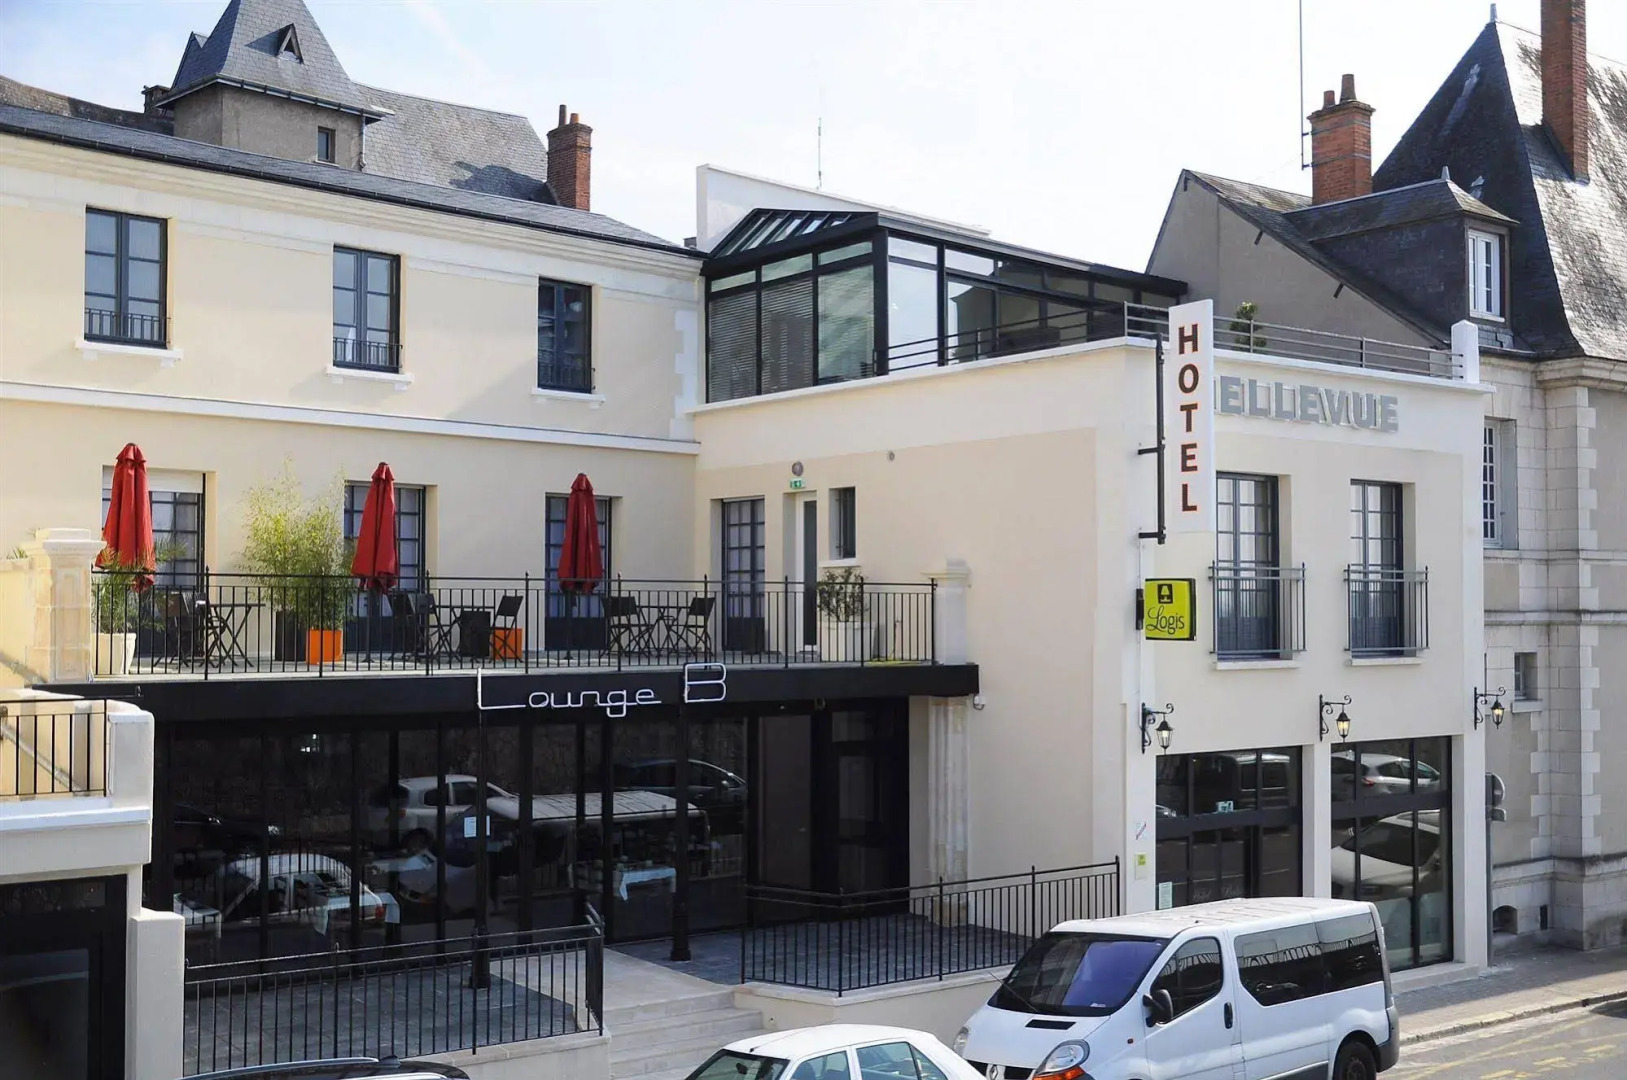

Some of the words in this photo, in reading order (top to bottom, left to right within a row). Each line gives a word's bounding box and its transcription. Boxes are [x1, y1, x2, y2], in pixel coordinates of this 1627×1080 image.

[1178, 324, 1200, 512] HOTEL
[1213, 375, 1399, 432] ELLEVUE
[1145, 604, 1186, 636] Logis
[476, 666, 662, 718] Lounge
[683, 662, 727, 704] B
